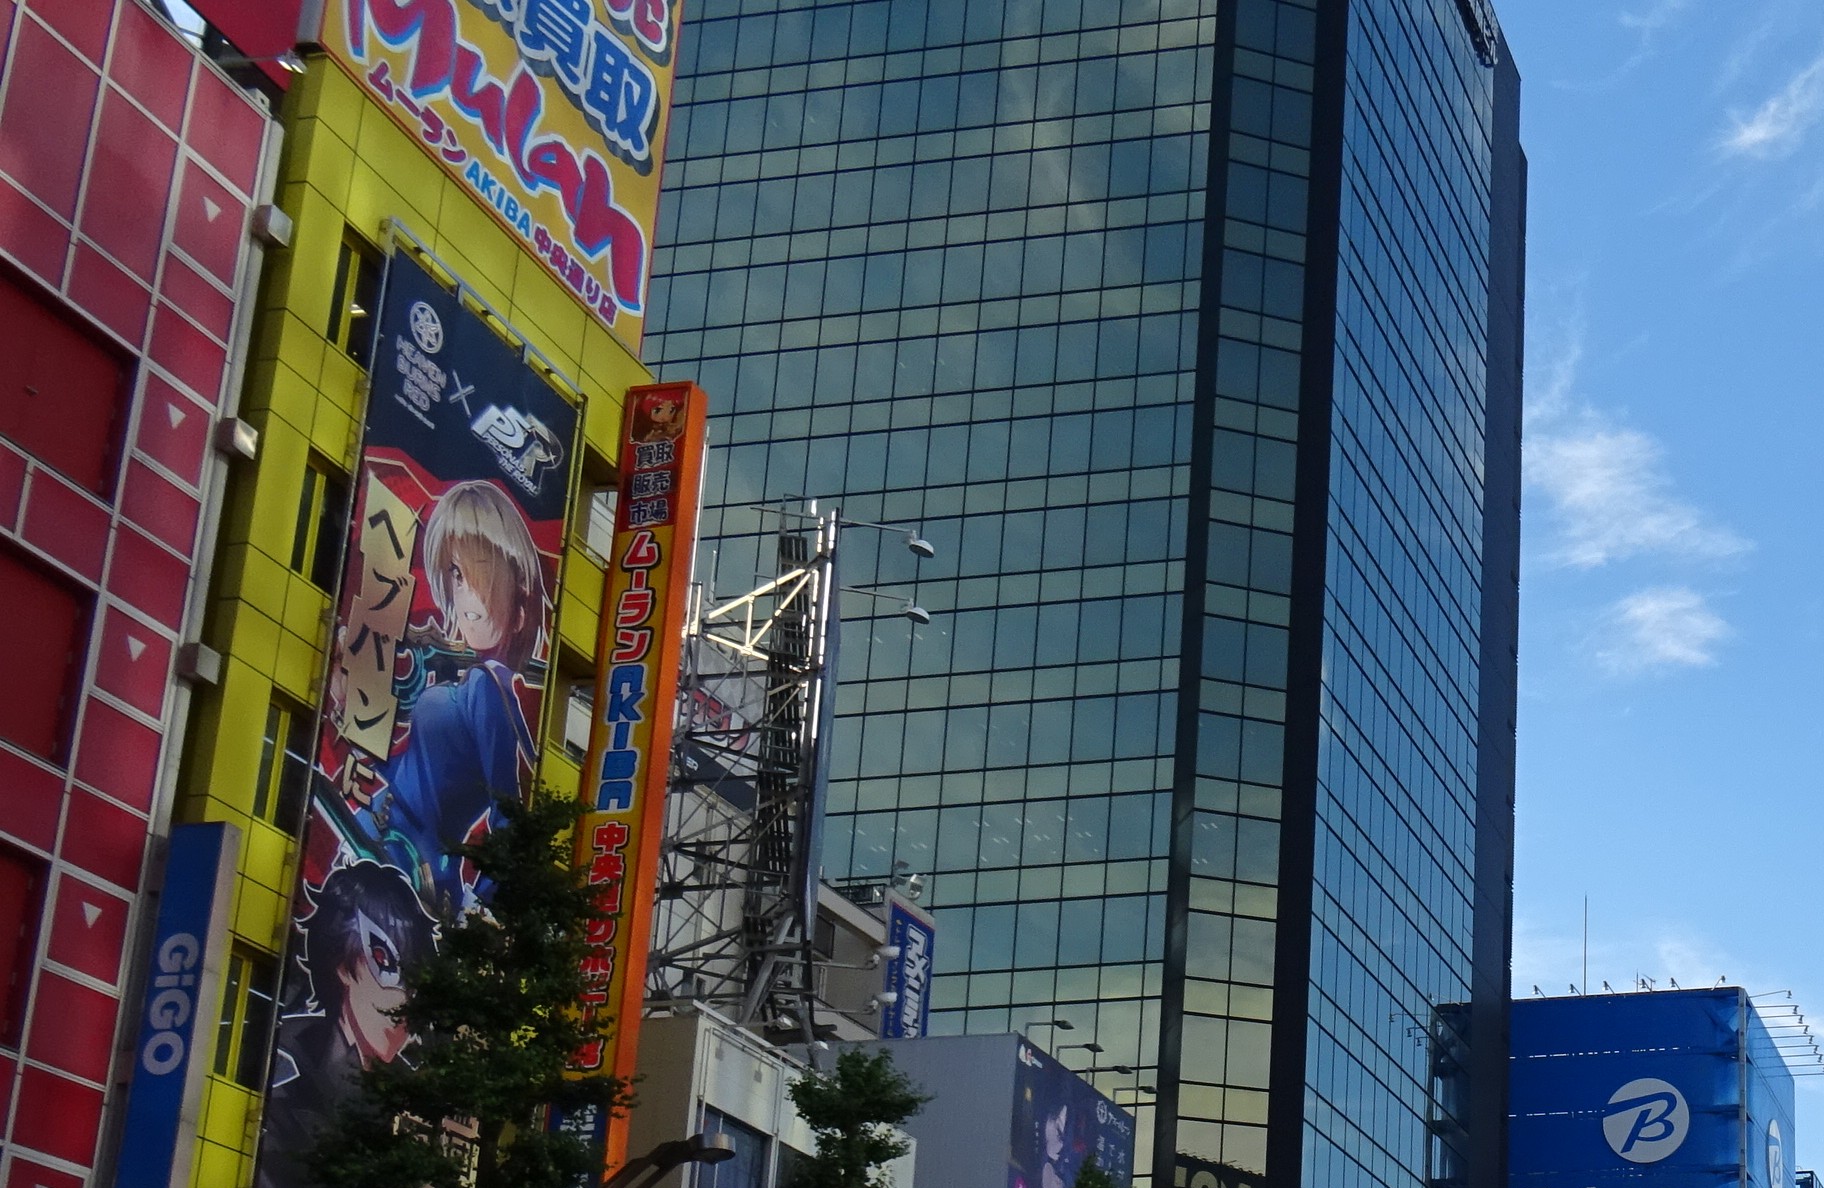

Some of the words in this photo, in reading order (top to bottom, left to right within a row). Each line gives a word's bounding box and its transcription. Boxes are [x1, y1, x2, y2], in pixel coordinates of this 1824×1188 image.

[367, 62, 467, 163] ムーラン
[465, 161, 533, 239] AKIBA
[533, 227, 617, 328] 中央通り店
[629, 497, 669, 525] 市場
[632, 472, 671, 497] 販売
[635, 441, 675, 467] 買取
[611, 529, 659, 664] ムーラン
[595, 663, 648, 812] AKIBA
[141, 931, 200, 1077] GiGO
